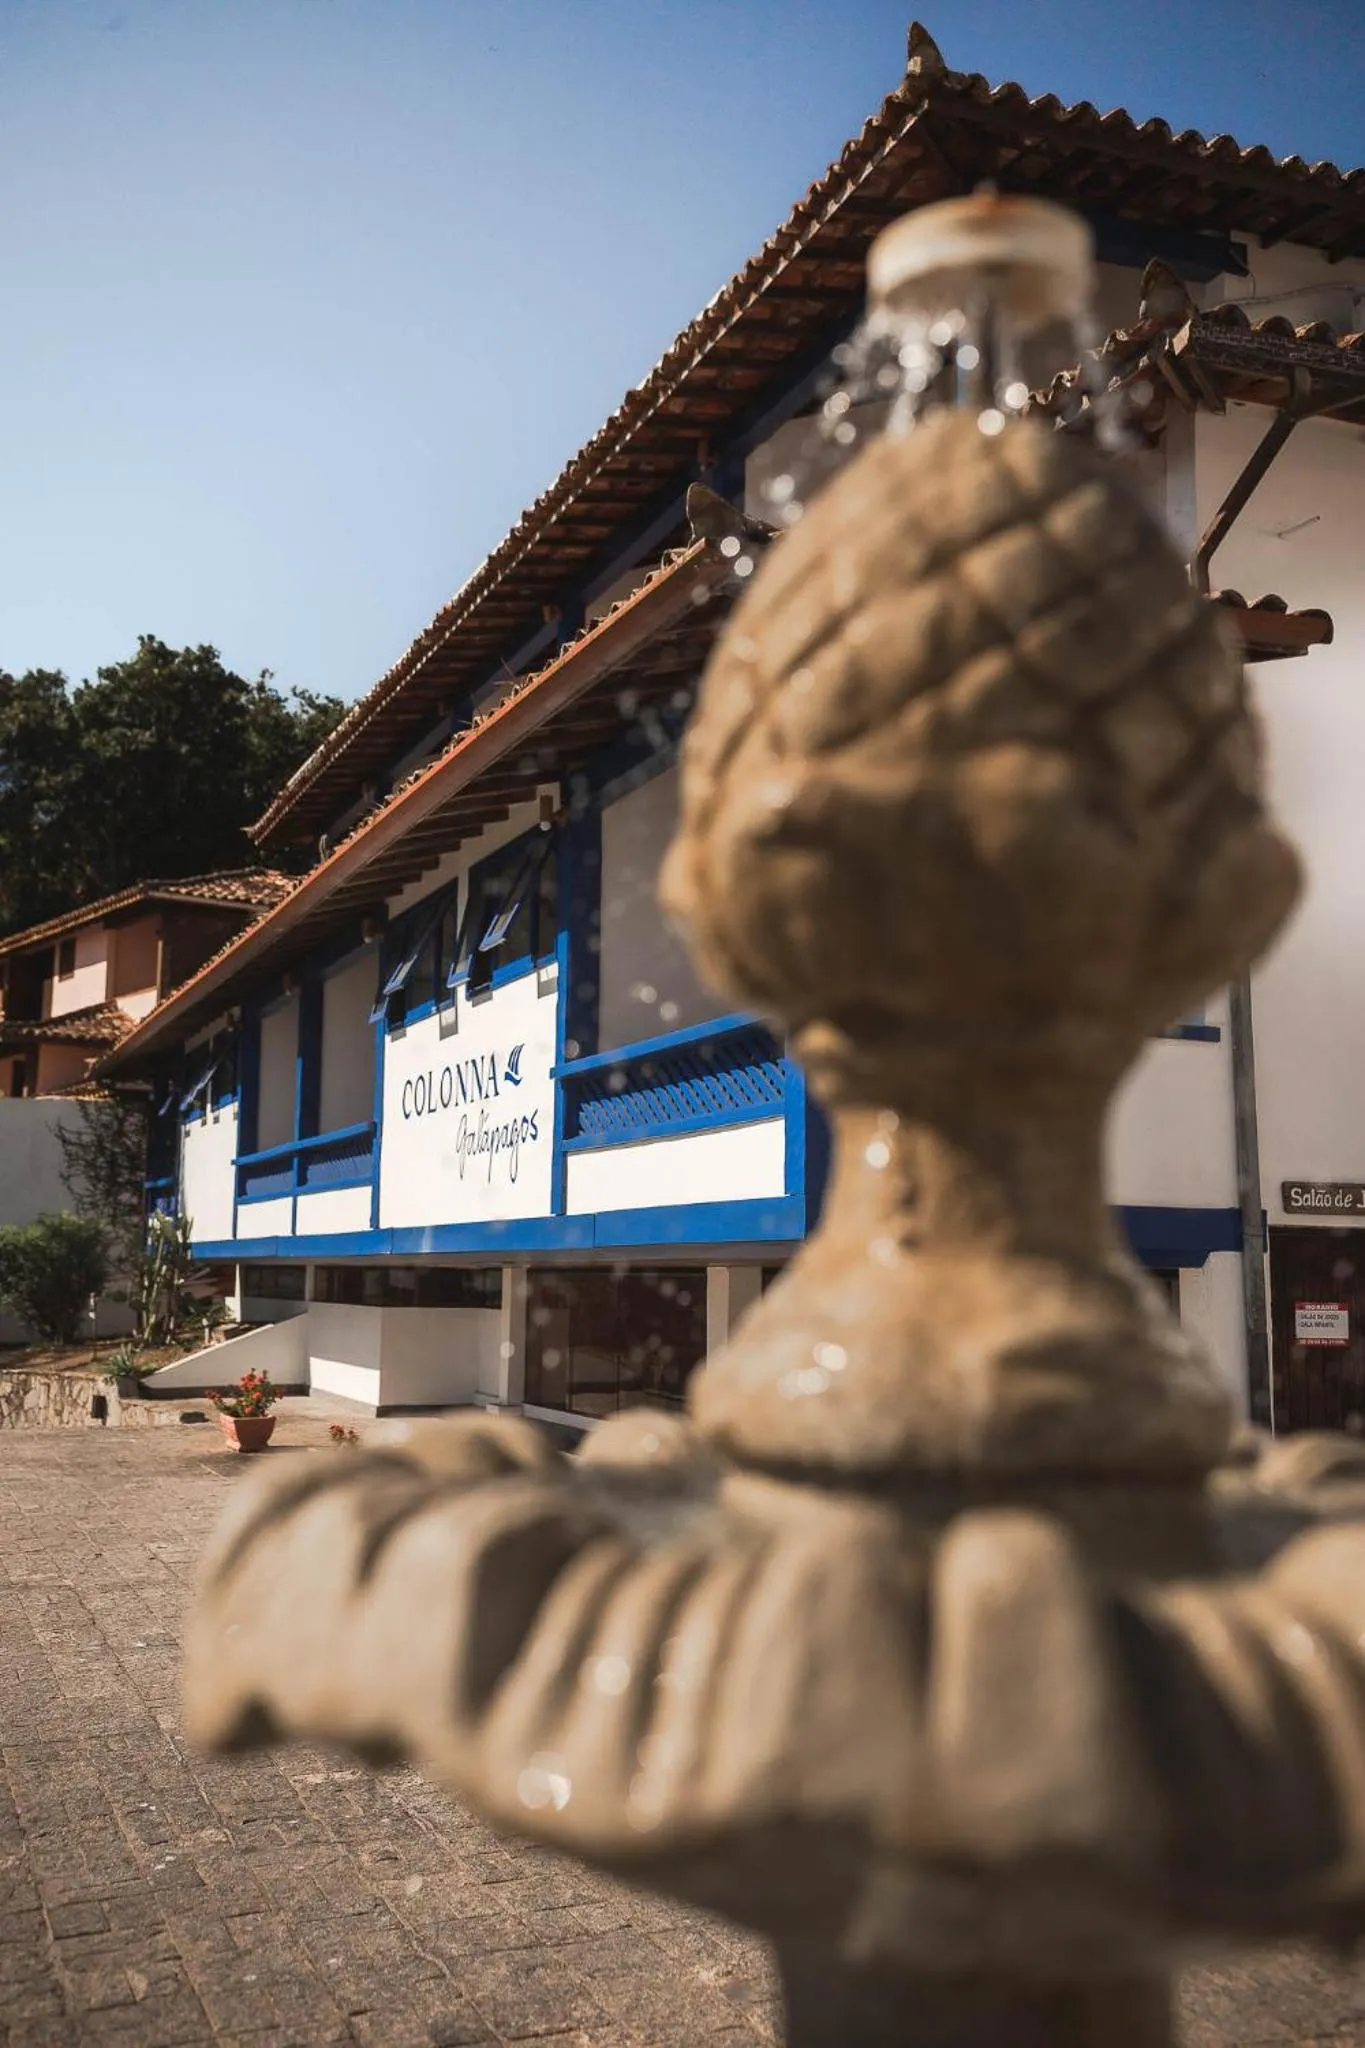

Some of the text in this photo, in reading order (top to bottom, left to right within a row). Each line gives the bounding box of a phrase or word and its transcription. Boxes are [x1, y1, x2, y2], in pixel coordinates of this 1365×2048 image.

[402, 1050, 500, 1120] COLONNA
[1290, 1187, 1332, 1207] Salão
[1334, 1188, 1353, 1208] de
